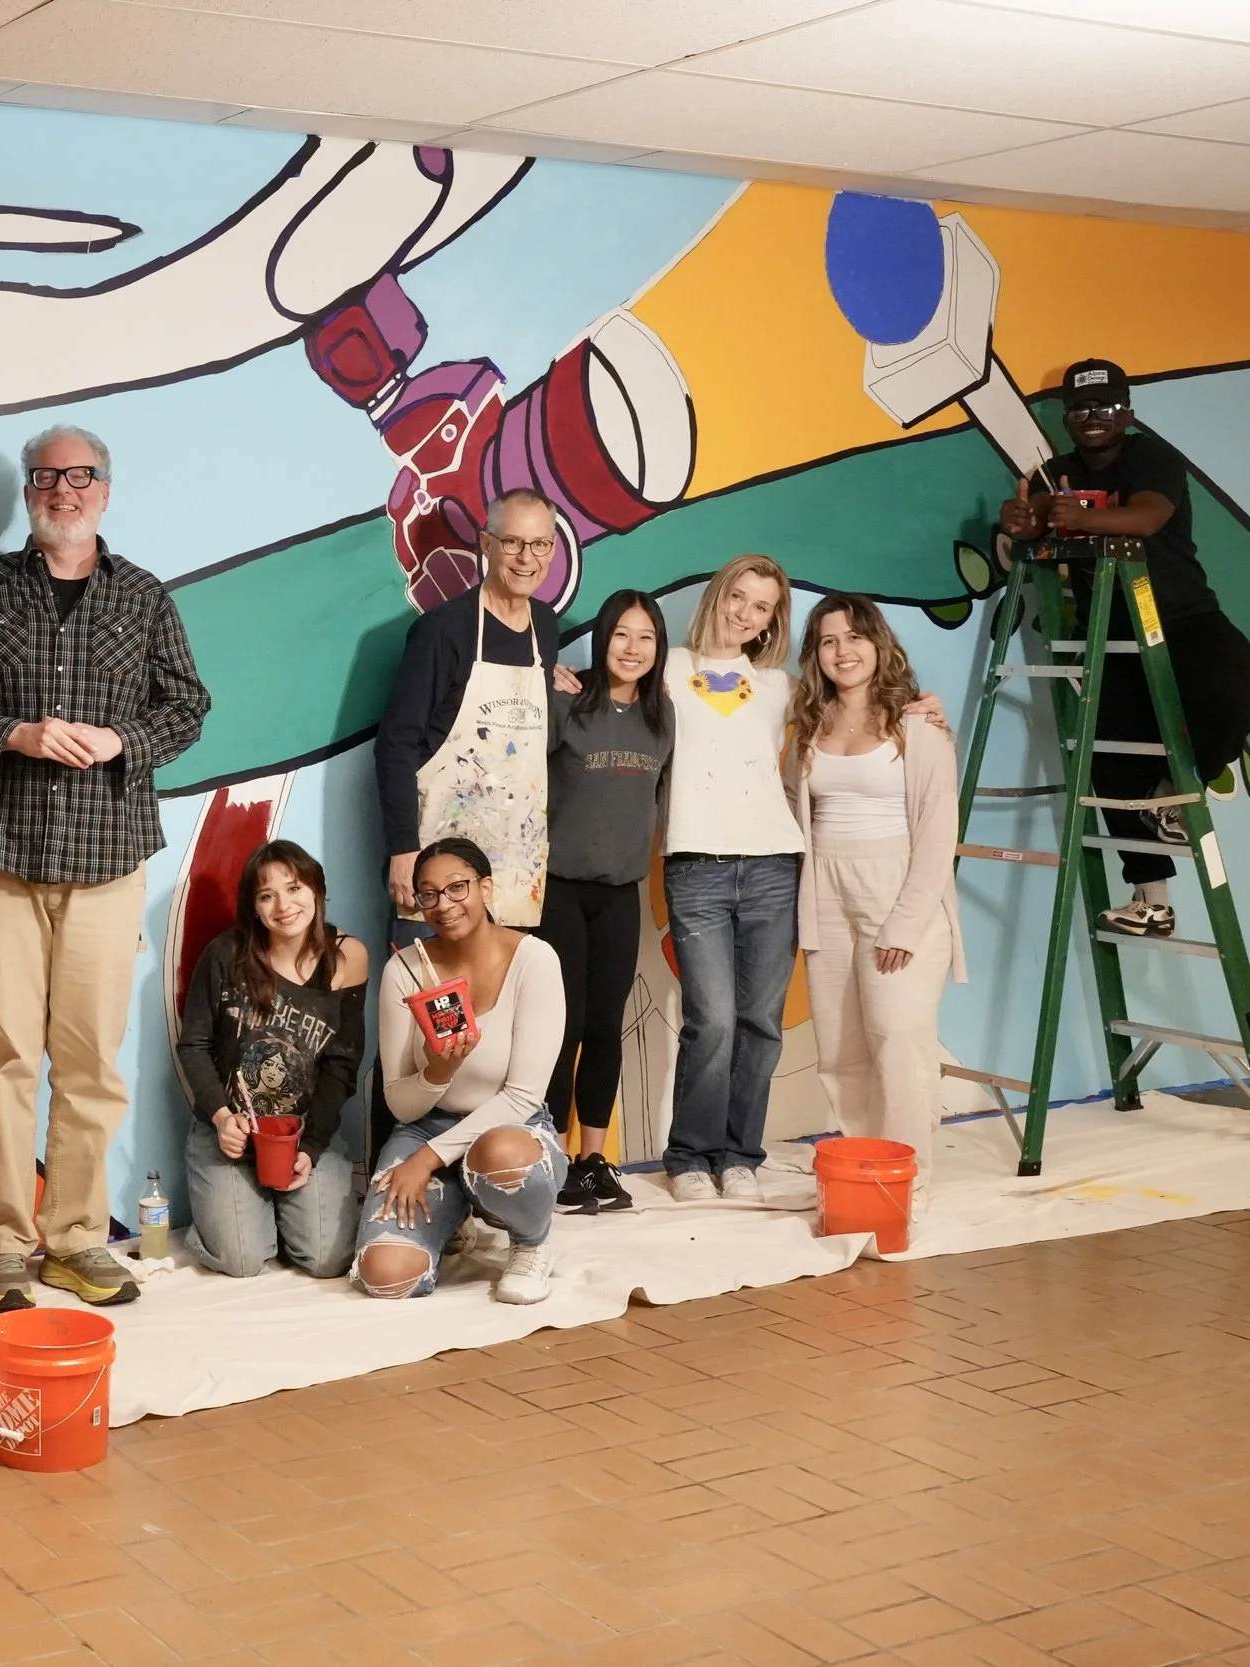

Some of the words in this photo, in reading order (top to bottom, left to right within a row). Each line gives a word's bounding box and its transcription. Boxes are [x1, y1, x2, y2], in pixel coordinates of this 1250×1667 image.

[478, 698, 519, 715] WINSOR
[585, 751, 610, 769] SAN
[297, 1013, 337, 1058] ART
